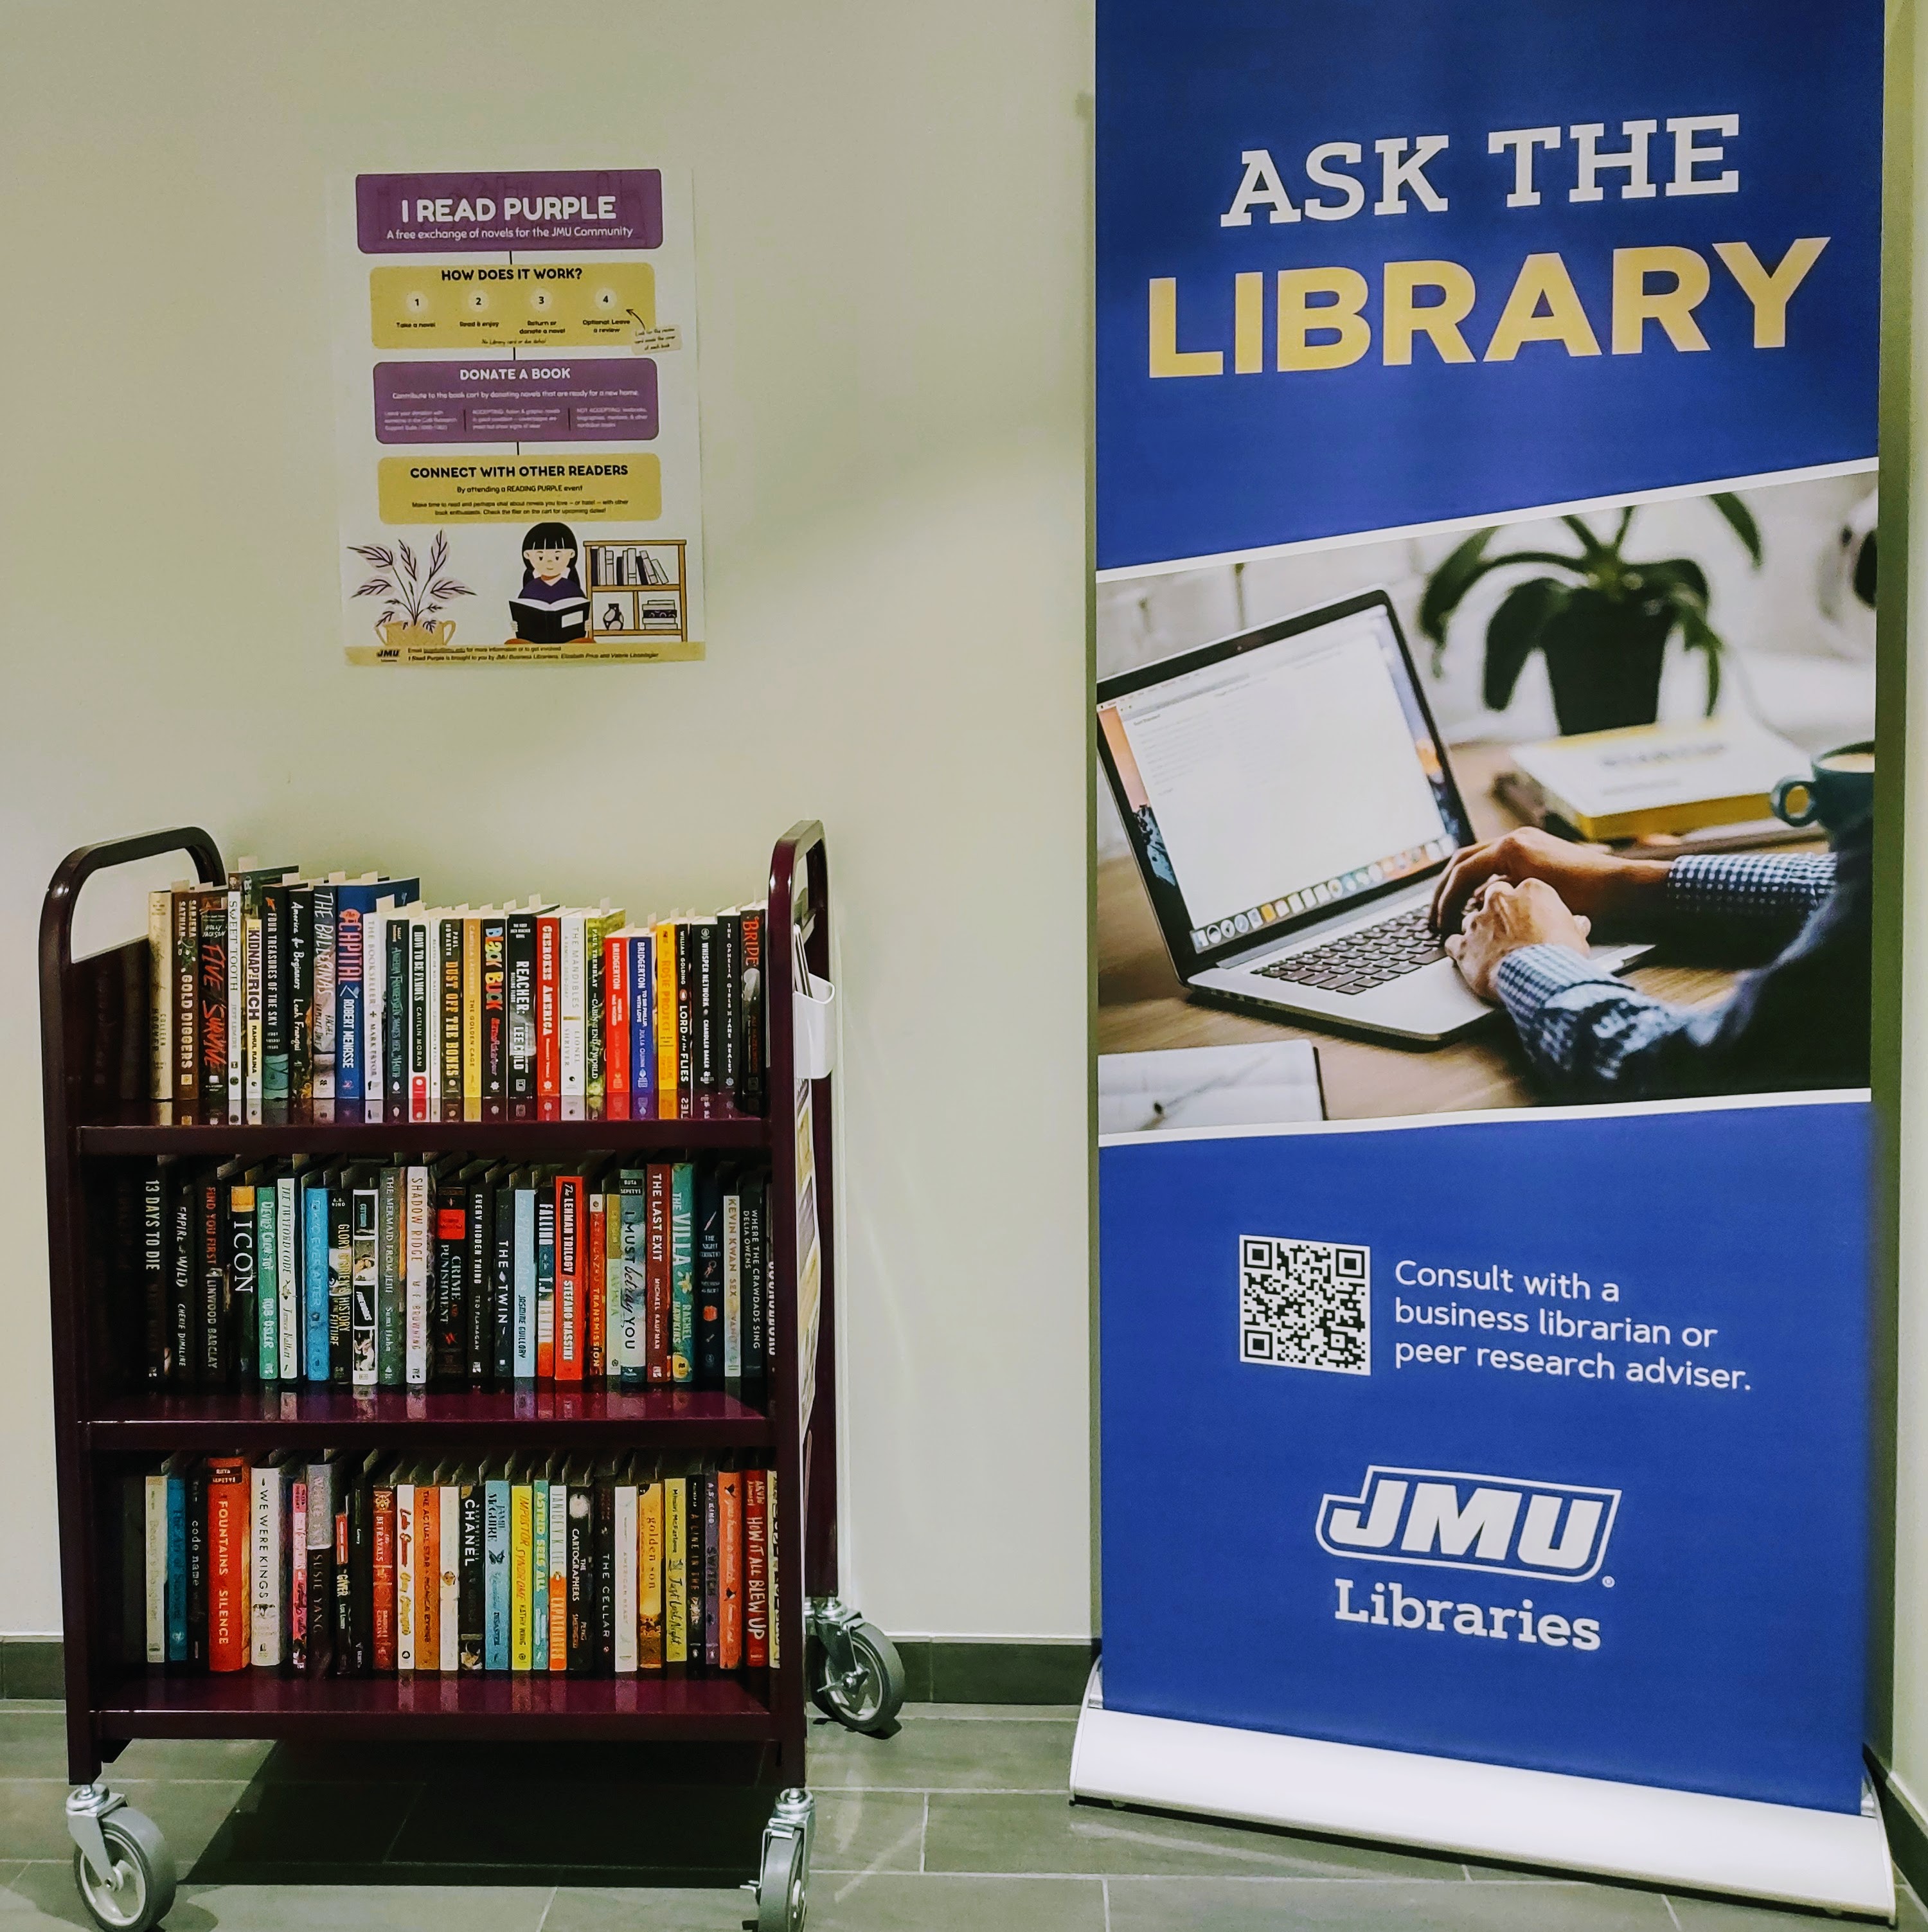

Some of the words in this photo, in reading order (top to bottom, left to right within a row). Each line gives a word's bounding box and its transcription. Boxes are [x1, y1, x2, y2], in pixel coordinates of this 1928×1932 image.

[1220, 136, 1449, 227] ASK
[1488, 114, 1739, 208] THE
[402, 200, 408, 222] I
[417, 199, 495, 222] READ
[504, 196, 616, 220] PURPLE
[387, 231, 394, 239] A
[395, 231, 416, 239] free
[418, 229, 467, 240] exchange
[469, 228, 479, 237] of
[481, 228, 513, 237] novels
[515, 228, 530, 237] for
[532, 228, 549, 237] the
[551, 227, 571, 237] JMU
[575, 226, 633, 237] Community
[442, 270, 474, 280] HOW
[479, 269, 513, 280] DOES
[518, 269, 530, 279] IT
[533, 268, 582, 279] WORK?
[1148, 237, 1831, 378] LIBRARY
[460, 370, 515, 380] DONATE
[519, 370, 528, 379] A
[531, 368, 571, 379] BOOK
[411, 467, 476, 478] CONNECT
[481, 467, 515, 477] WITH
[519, 467, 565, 476] OTHER
[569, 465, 628, 476] READERS
[315, 893, 333, 918] THE
[229, 901, 238, 944] SWEET
[267, 913, 277, 933] FOUR
[249, 930, 260, 972] KIDNAP
[338, 923, 362, 985] CAPITAL
[414, 931, 424, 948] HOW
[414, 950, 424, 959] TO
[742, 917, 759, 966] BRIDE
[202, 944, 224, 990] FIVE
[267, 936, 277, 978] TREASURES
[315, 924, 334, 996] BALLERINAS
[414, 960, 424, 971] BE
[612, 944, 621, 989] BRIDGERTON
[638, 942, 646, 988] BRIDGERTON
[414, 973, 425, 1001] FAMOUS
[446, 962, 459, 988] DUST
[516, 962, 529, 1014] REACHER:
[181, 975, 193, 1008] GOLD
[249, 979, 260, 1020] RICH
[268, 994, 277, 1009] THE
[446, 993, 459, 1012] OFF
[267, 1012, 277, 1026] SKY
[343, 999, 353, 1028] ROBERT
[446, 1017, 459, 1039] THE
[679, 1006, 688, 1033] LORD
[181, 1013, 193, 1068] DIGGERS
[202, 1001, 226, 1066] SURVIVE
[343, 1031, 355, 1068] MENASSE
[513, 1027, 524, 1042] LEE
[447, 1042, 459, 1076] BONES
[513, 1046, 524, 1069] CHILD
[146, 1179, 159, 1192] 13
[411, 1177, 423, 1224] SHADOW
[652, 1174, 662, 1196] THE
[146, 1197, 159, 1227] DAYS
[652, 1201, 662, 1231] LAST
[672, 1193, 682, 1210] THE
[147, 1232, 159, 1246] TO
[411, 1230, 423, 1262] RIDGE
[499, 1241, 509, 1268] THE
[652, 1235, 662, 1262] EXIT
[672, 1212, 691, 1266] VILLA
[146, 1251, 159, 1270] DIE
[234, 1221, 253, 1292] ICON
[451, 1256, 461, 1300] CRIME
[1395, 1260, 1513, 1292] Consult
[1523, 1272, 1591, 1300] with
[1602, 1284, 1620, 1302] a
[498, 1285, 508, 1323] TWIN
[1395, 1297, 1529, 1332] business
[1540, 1309, 1671, 1345] librarian
[1682, 1327, 1718, 1348] or
[1395, 1343, 1467, 1369] peer
[1477, 1347, 1615, 1380] research
[1625, 1357, 1751, 1390] adviser.
[259, 1490, 268, 1510] WE
[219, 1501, 228, 1575] FOUNTAINS
[259, 1515, 268, 1551] WERE
[465, 1499, 476, 1566] CHANEL
[747, 1517, 763, 1541] HOW
[1328, 1479, 1604, 1570] JMU
[750, 1557, 763, 1575] ALL
[755, 1545, 763, 1555] IT
[259, 1556, 269, 1598] KINGS
[748, 1580, 765, 1613] BLEW
[219, 1590, 229, 1644] SILENCE
[747, 1618, 766, 1640] UP
[1335, 1578, 1601, 1650] Libraries
